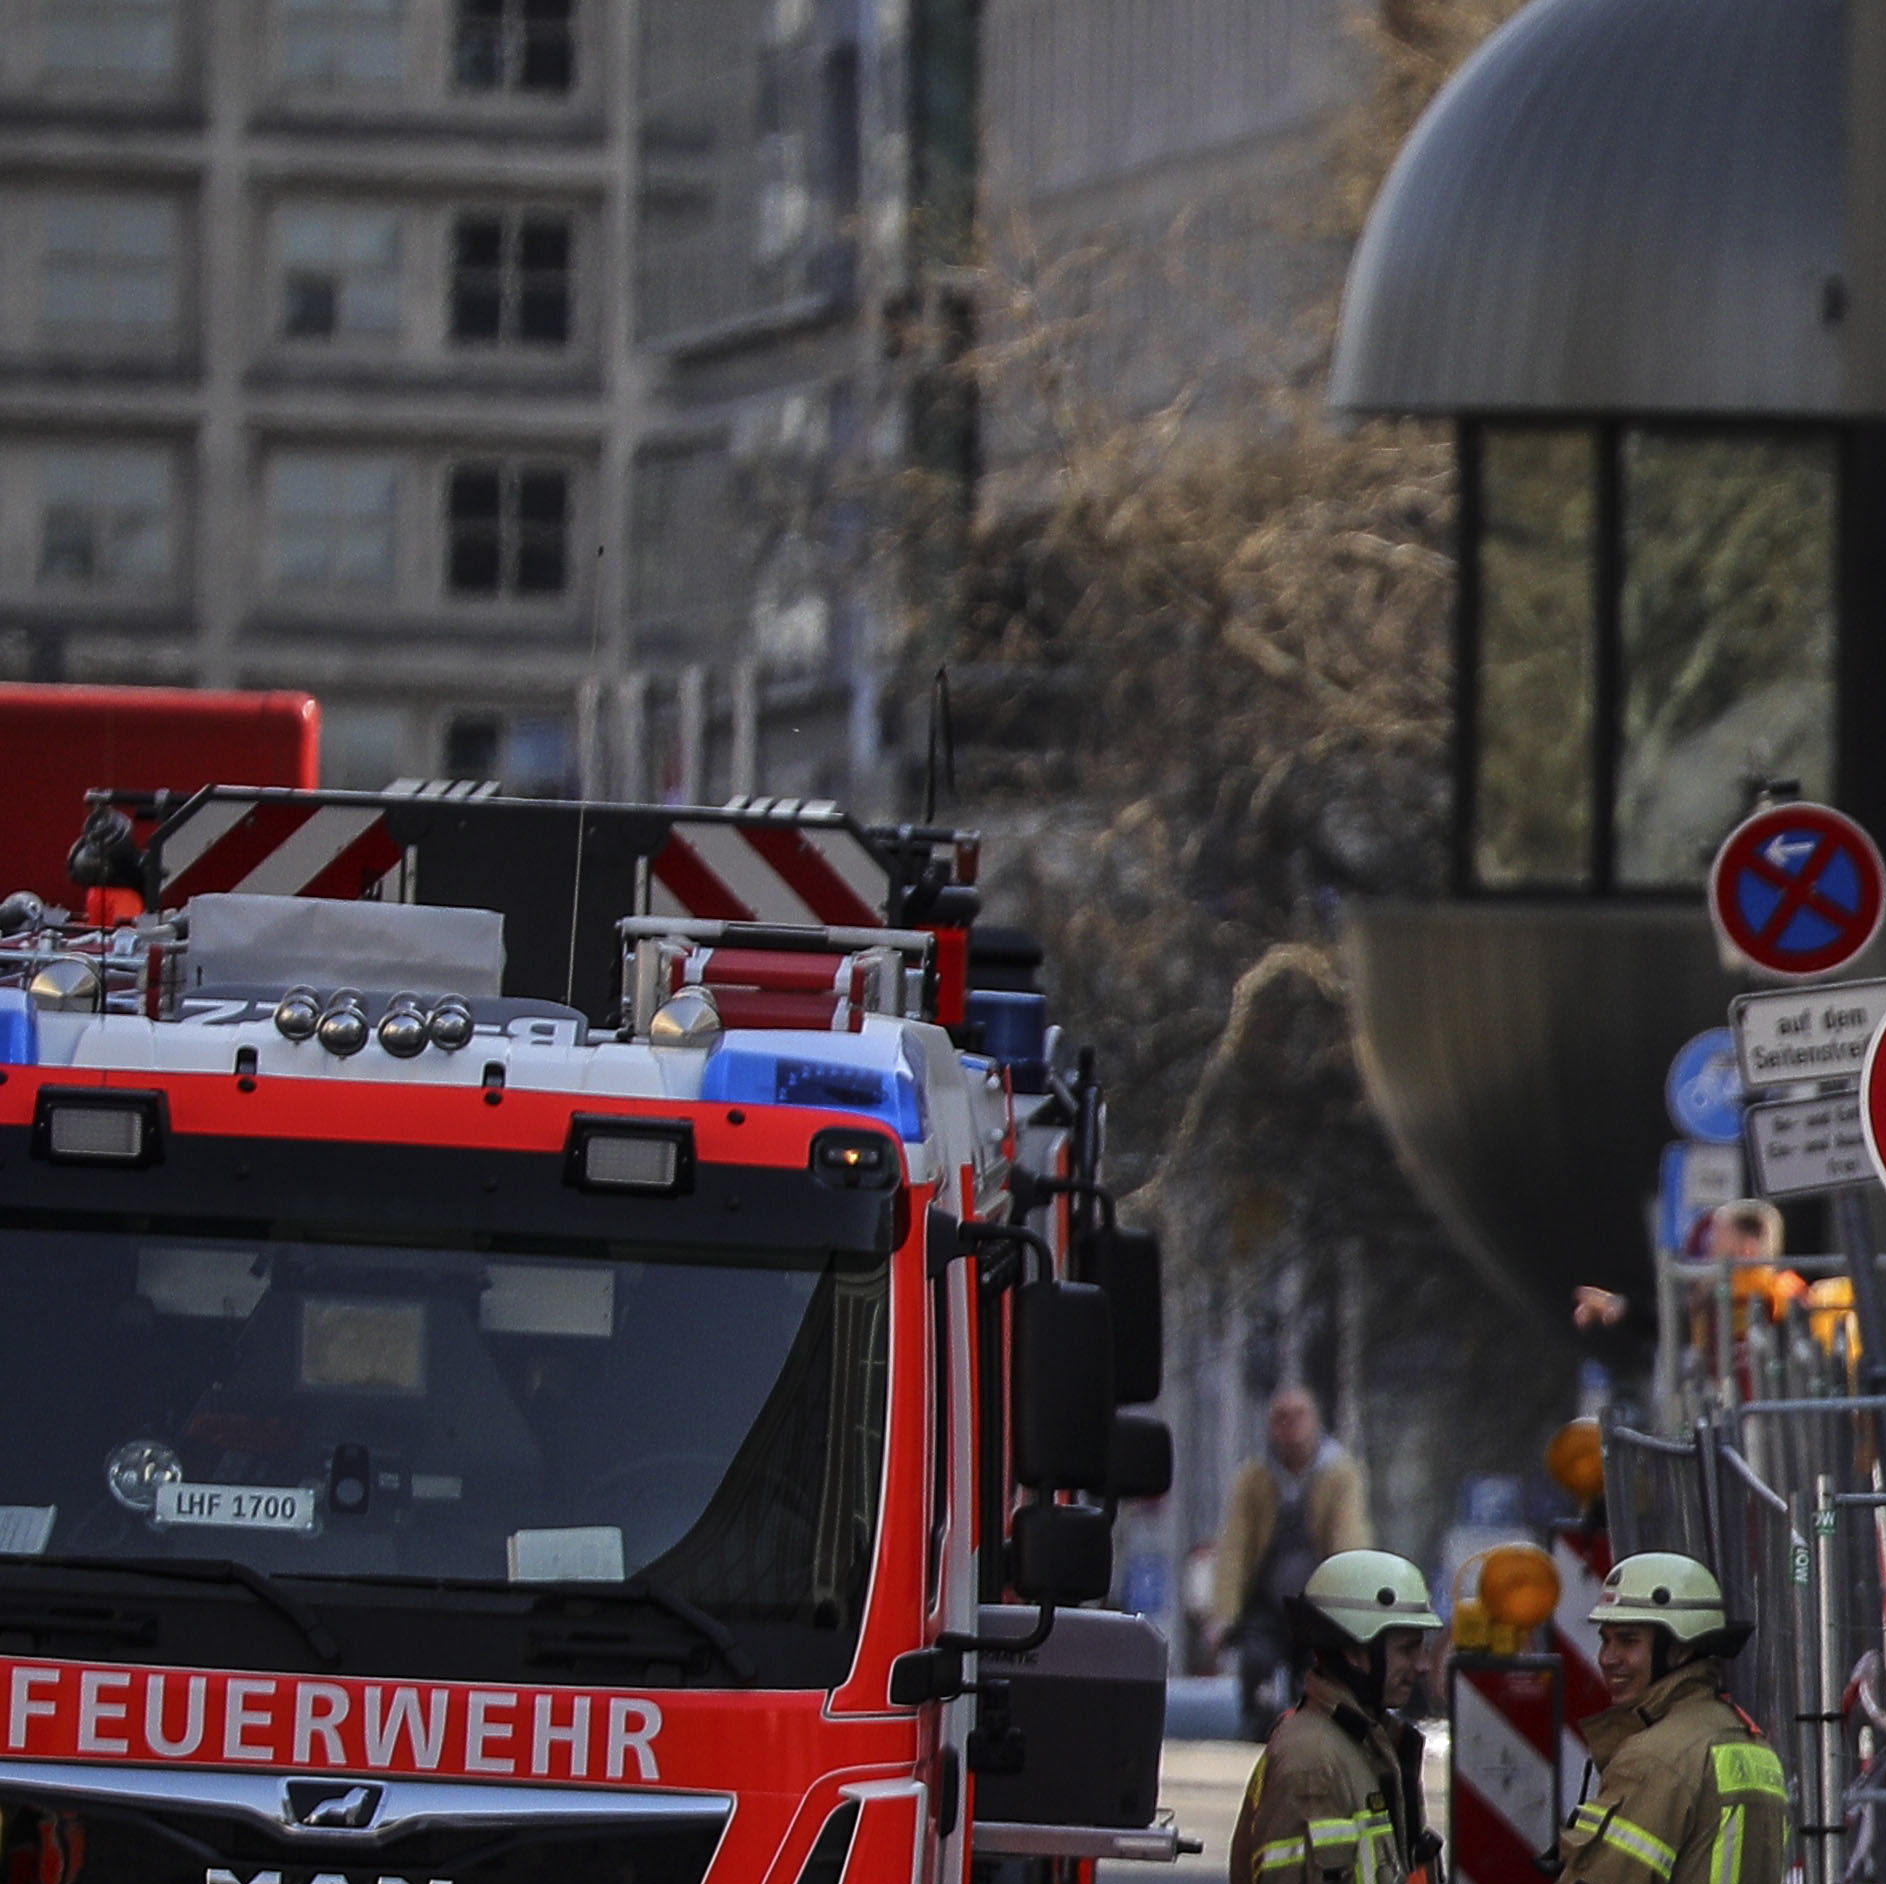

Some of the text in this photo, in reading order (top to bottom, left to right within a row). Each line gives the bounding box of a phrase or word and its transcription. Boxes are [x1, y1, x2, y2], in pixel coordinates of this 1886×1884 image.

[176, 1491, 296, 1520] LHF 1700
[7, 1667, 664, 1781] FEUERWEHR
